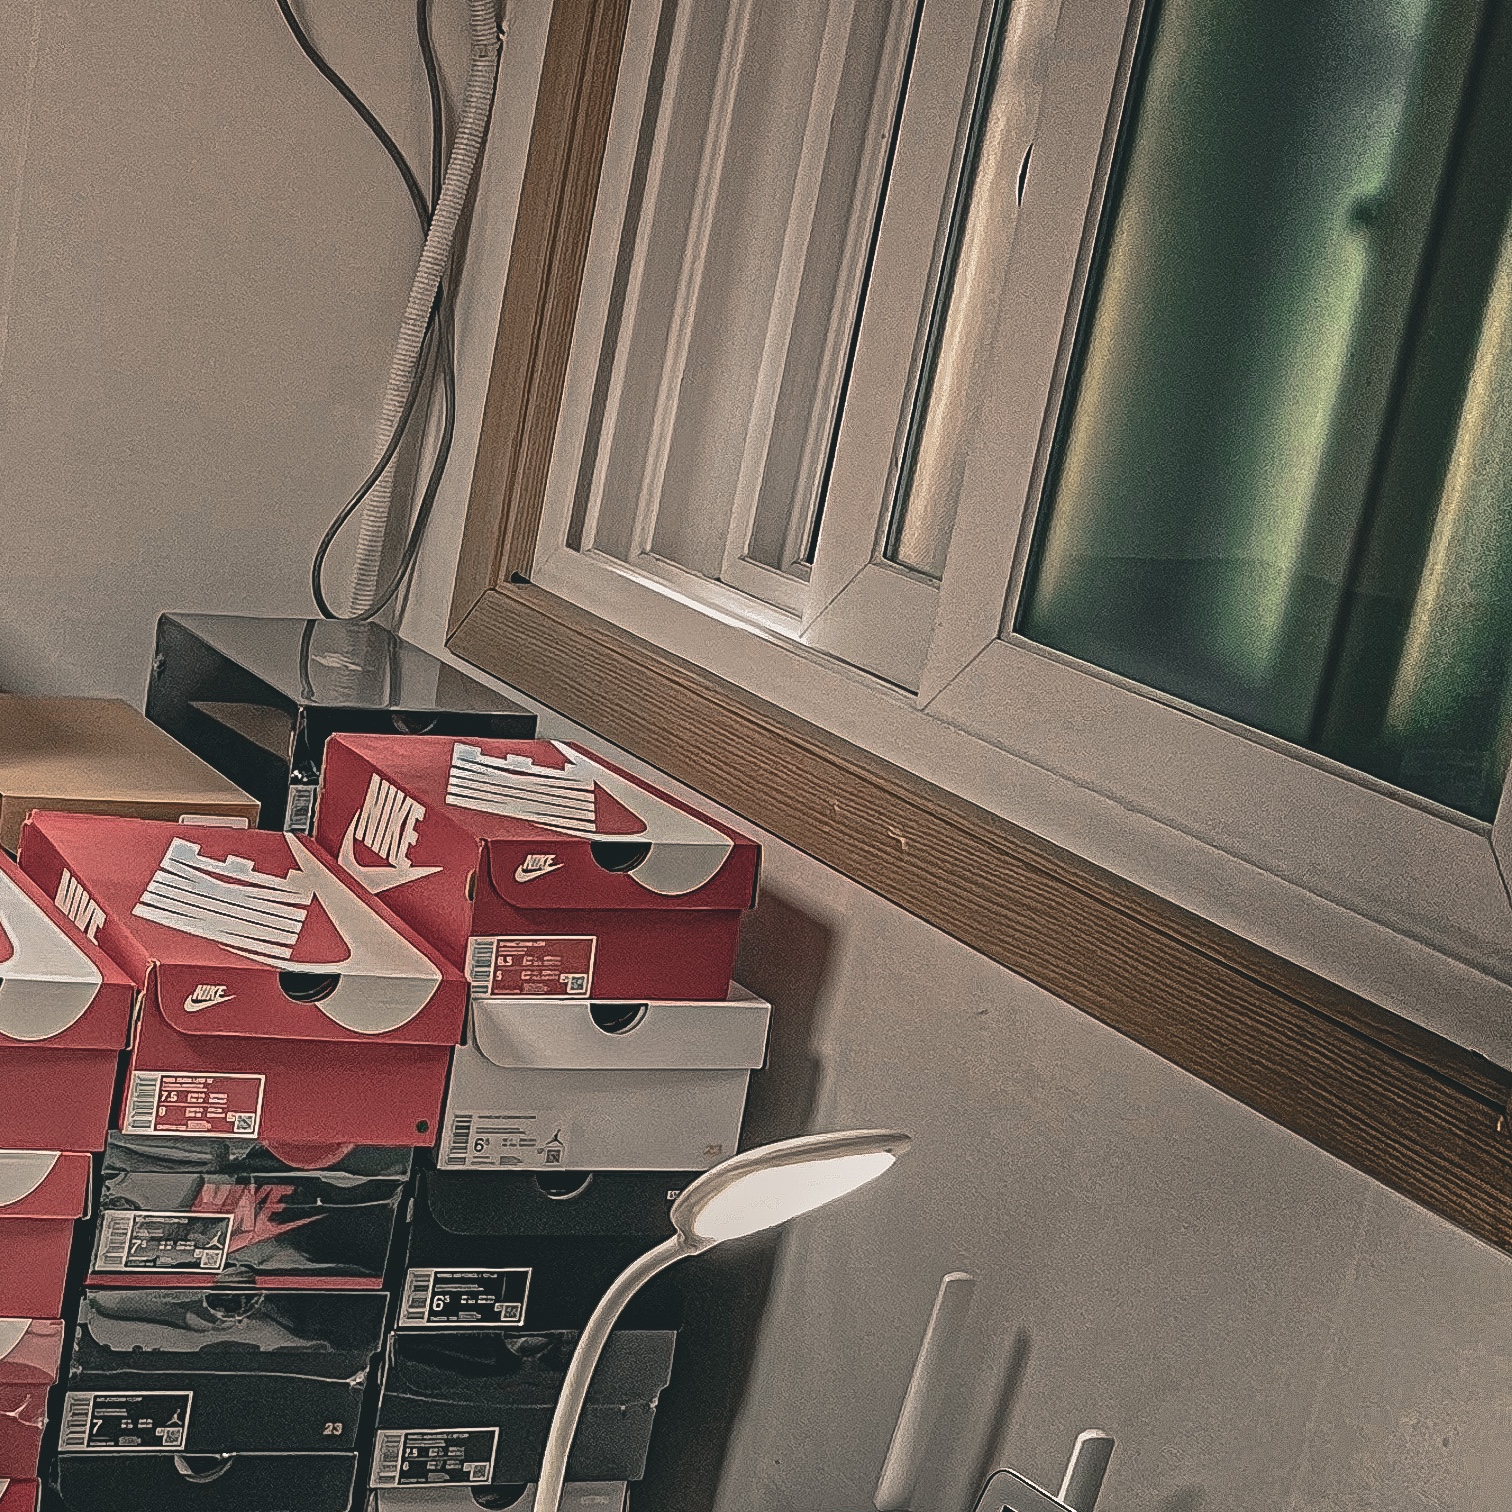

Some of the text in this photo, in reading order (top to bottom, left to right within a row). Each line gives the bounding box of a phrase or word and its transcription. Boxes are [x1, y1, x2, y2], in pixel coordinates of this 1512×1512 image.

[355, 772, 426, 868] NIKE
[193, 985, 228, 1001] NIKE
[161, 1092, 178, 1101] 7.5
[92, 1420, 102, 1434] 7
[323, 1423, 343, 1435] 23
